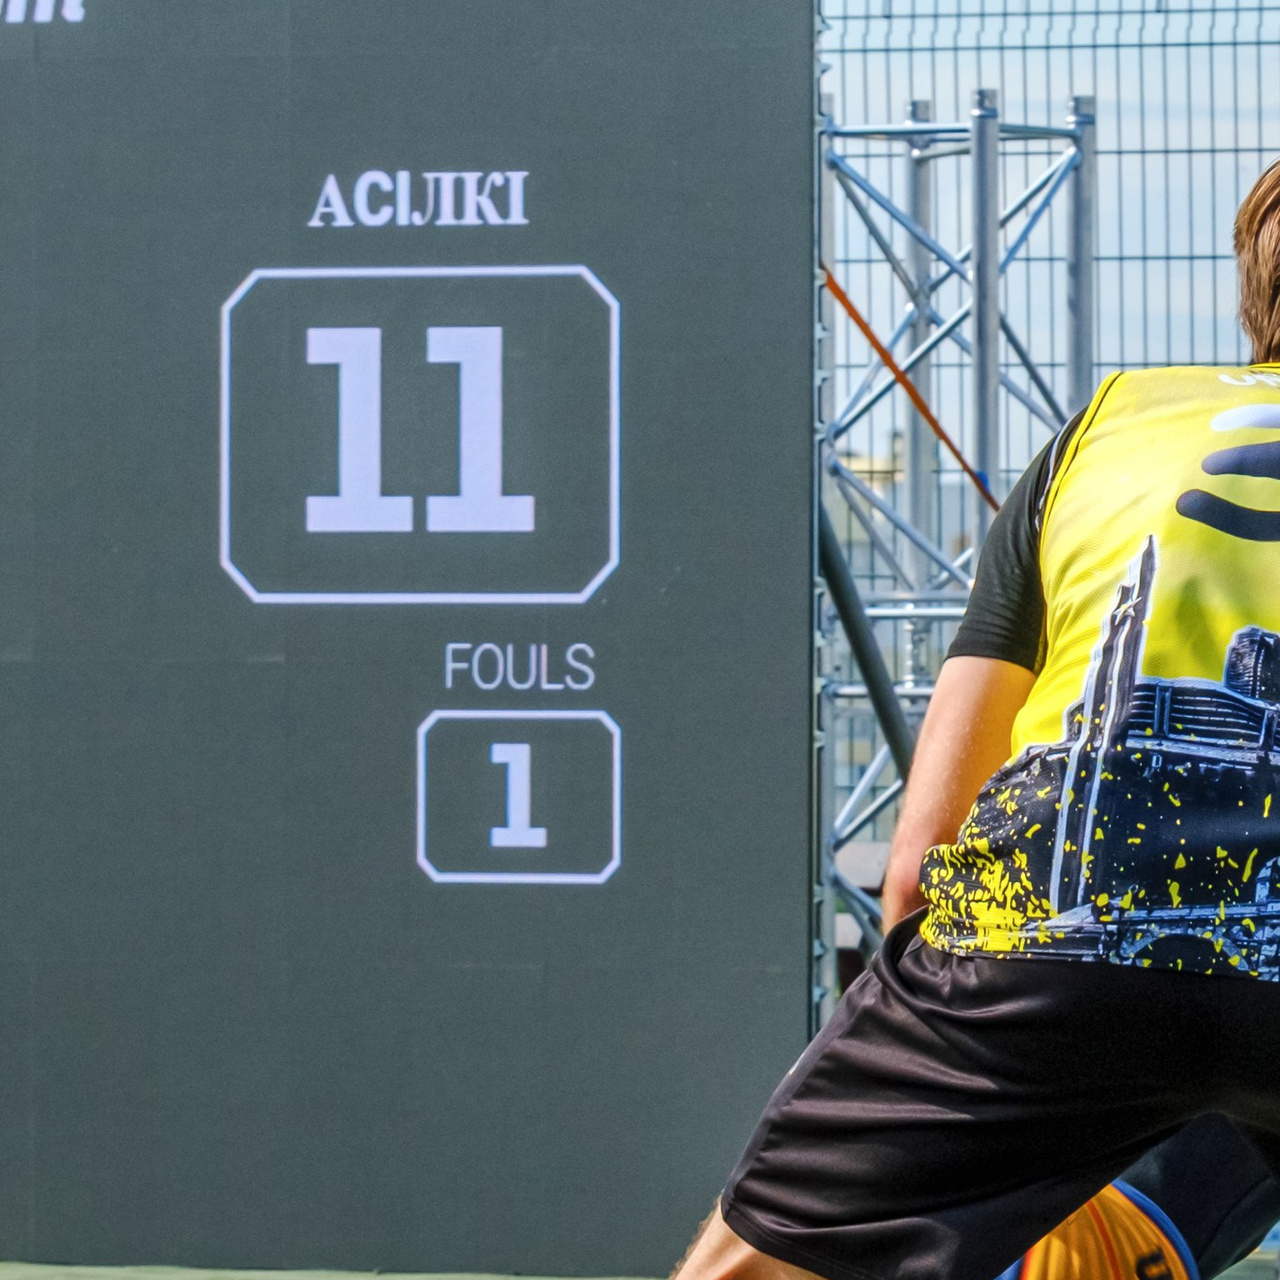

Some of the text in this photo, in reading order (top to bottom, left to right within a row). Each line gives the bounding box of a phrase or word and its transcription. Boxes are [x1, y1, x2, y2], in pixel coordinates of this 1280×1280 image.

[305, 325, 535, 533] 11
[444, 642, 596, 691] FOULS
[490, 742, 547, 848] 1
